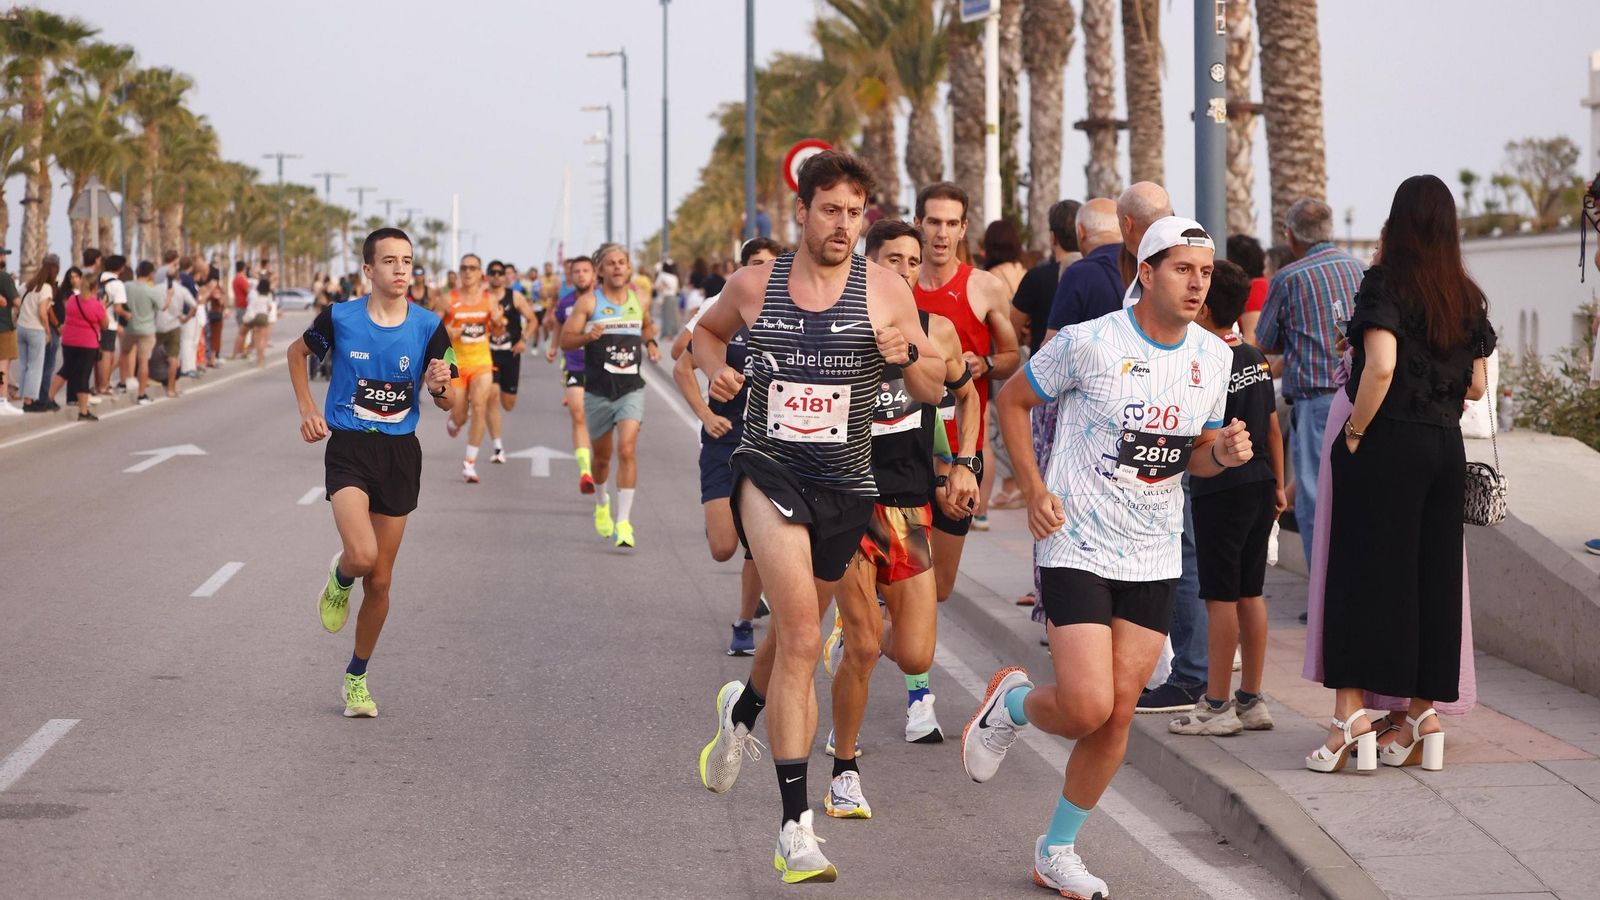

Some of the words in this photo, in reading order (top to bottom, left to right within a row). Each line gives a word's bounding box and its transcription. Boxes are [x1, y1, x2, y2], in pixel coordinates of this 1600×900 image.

[786, 349, 862, 368] abelenda
[364, 388, 407, 402] 2894
[784, 396, 832, 413] 4181
[1145, 405, 1180, 431] 26
[1133, 445, 1181, 463] 2818
